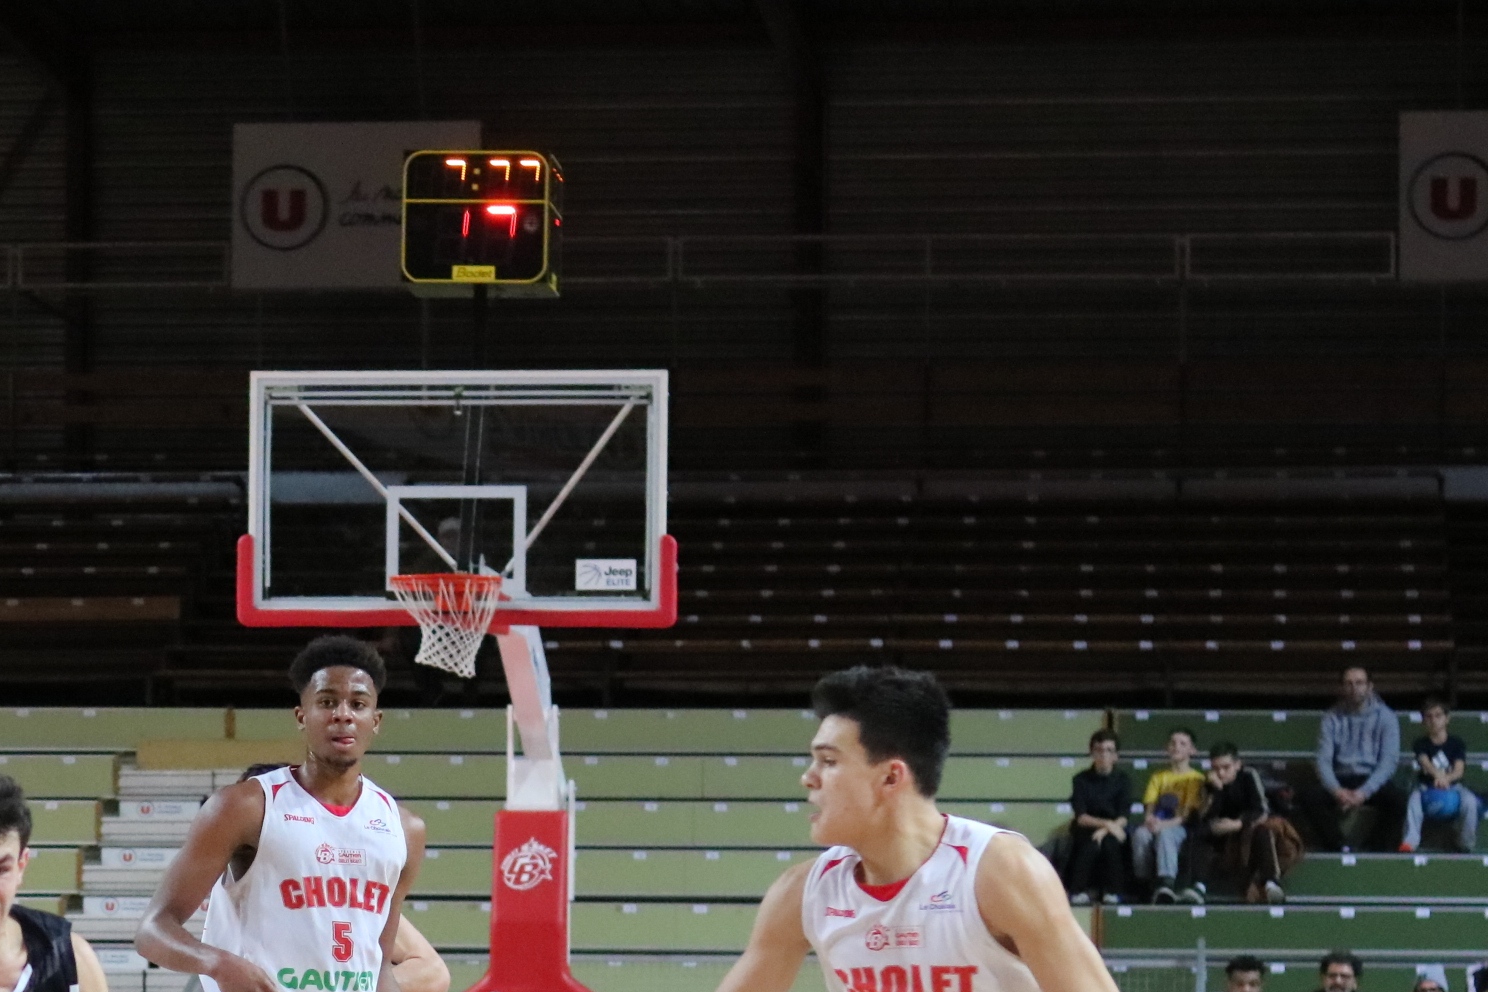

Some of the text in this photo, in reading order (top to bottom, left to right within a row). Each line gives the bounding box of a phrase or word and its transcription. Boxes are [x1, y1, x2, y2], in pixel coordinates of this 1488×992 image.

[262, 188, 307, 232] U
[1430, 176, 1478, 221] U
[604, 566, 632, 577] Jeep
[284, 813, 315, 825] SPALDING
[279, 876, 390, 914] CHOLET
[332, 921, 354, 962] 5
